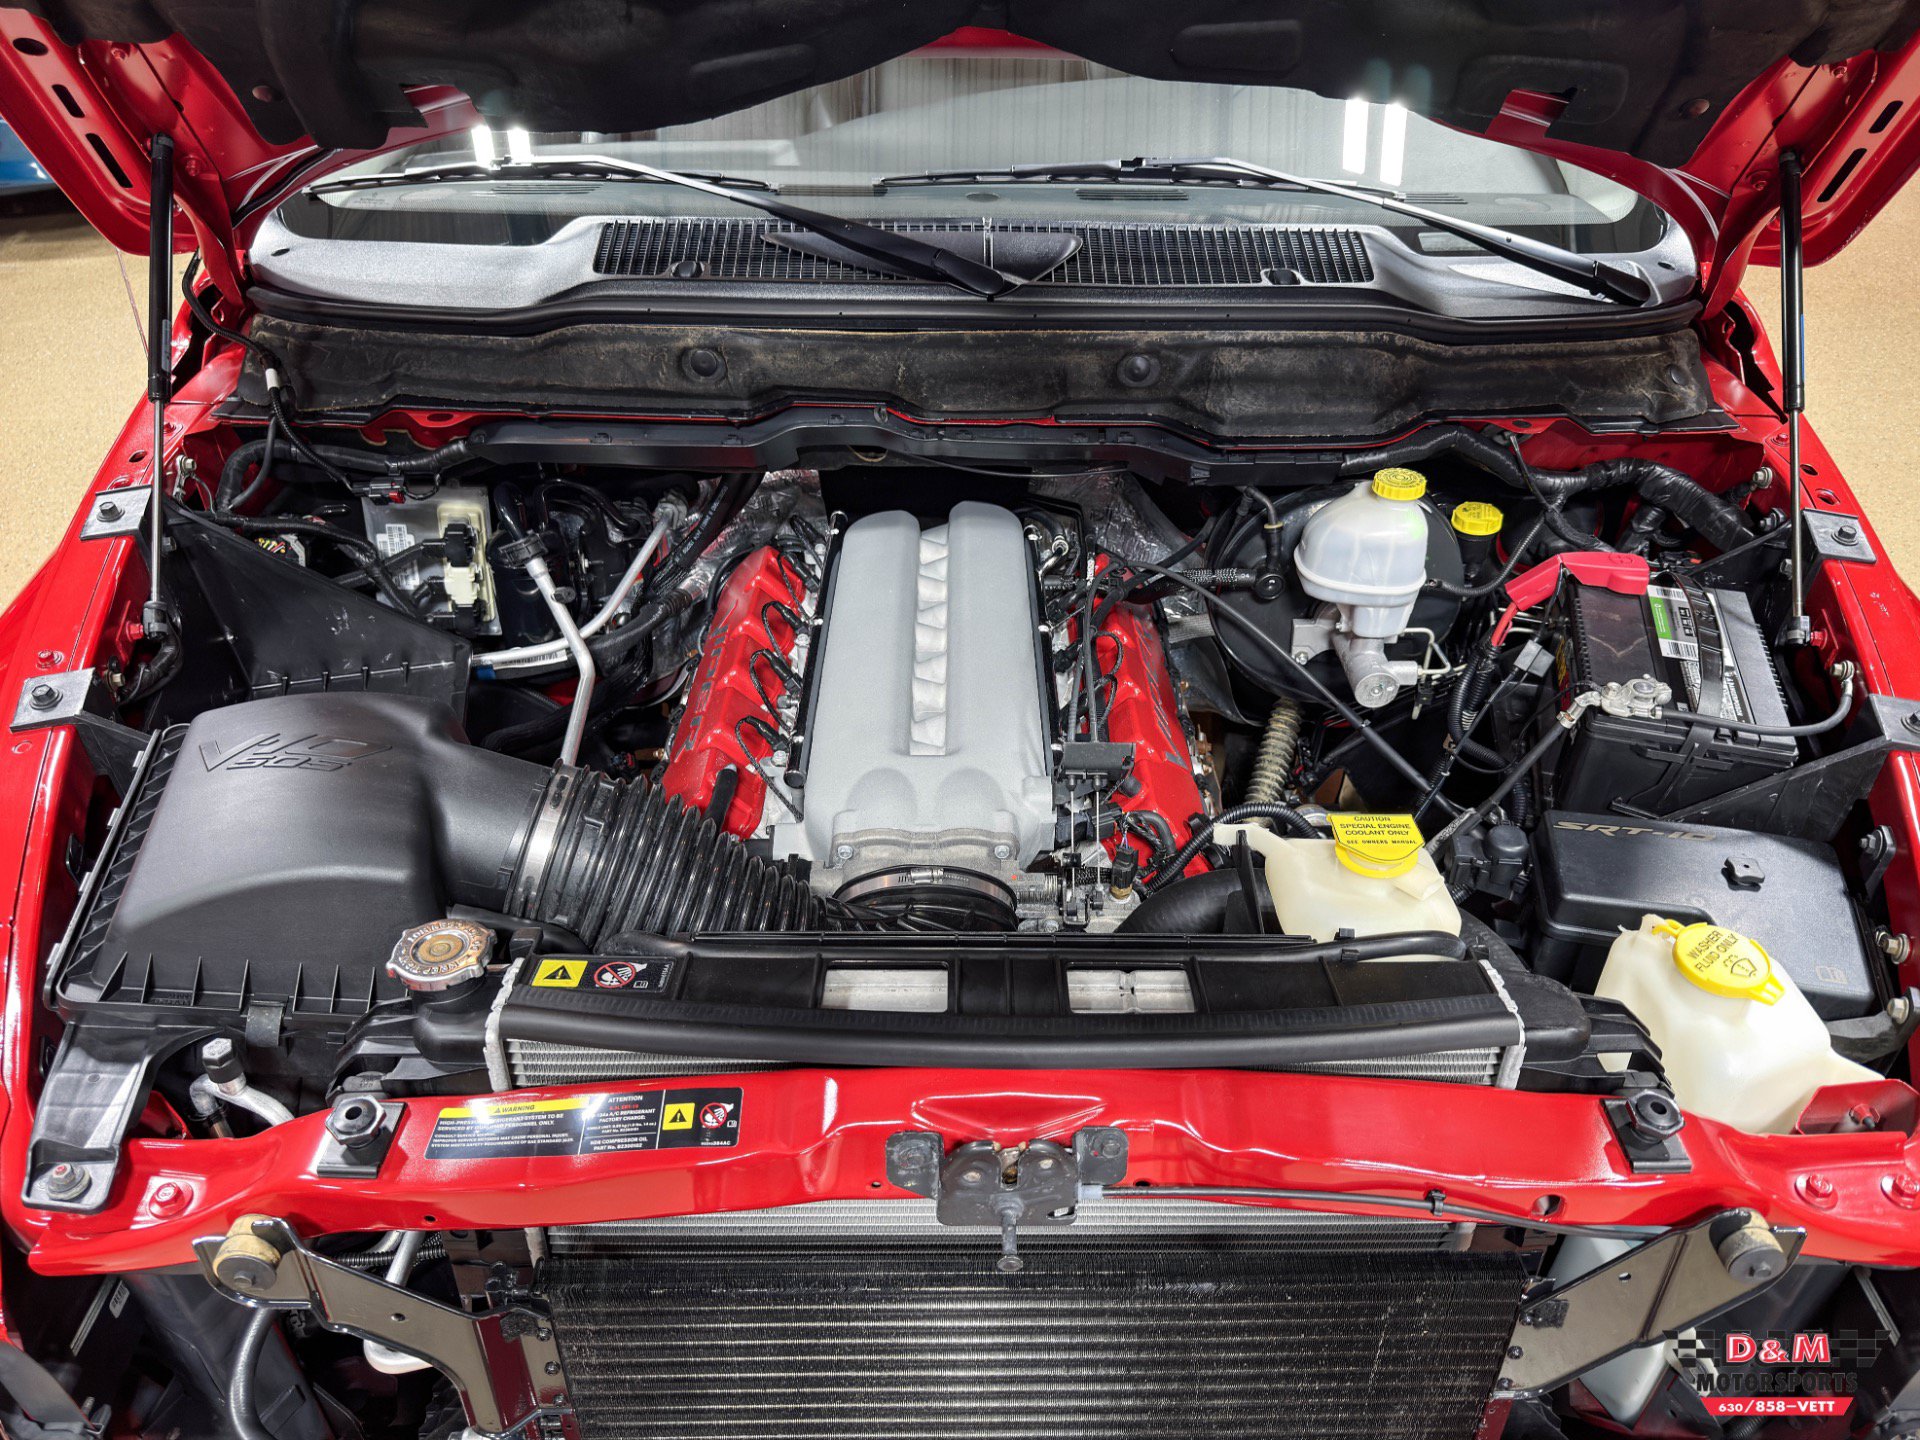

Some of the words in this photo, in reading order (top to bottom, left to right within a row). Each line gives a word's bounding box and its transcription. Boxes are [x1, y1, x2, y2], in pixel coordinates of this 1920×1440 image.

[1553, 821, 1717, 842] SRT-10
[1688, 930, 1723, 959] WASHER
[1694, 952, 1720, 973] FLUID
[1719, 933, 1739, 954] ONLY
[608, 1095, 643, 1103] ATTENTION
[502, 1104, 535, 1113] WARNING
[620, 1108, 656, 1116] REFRIGERANT
